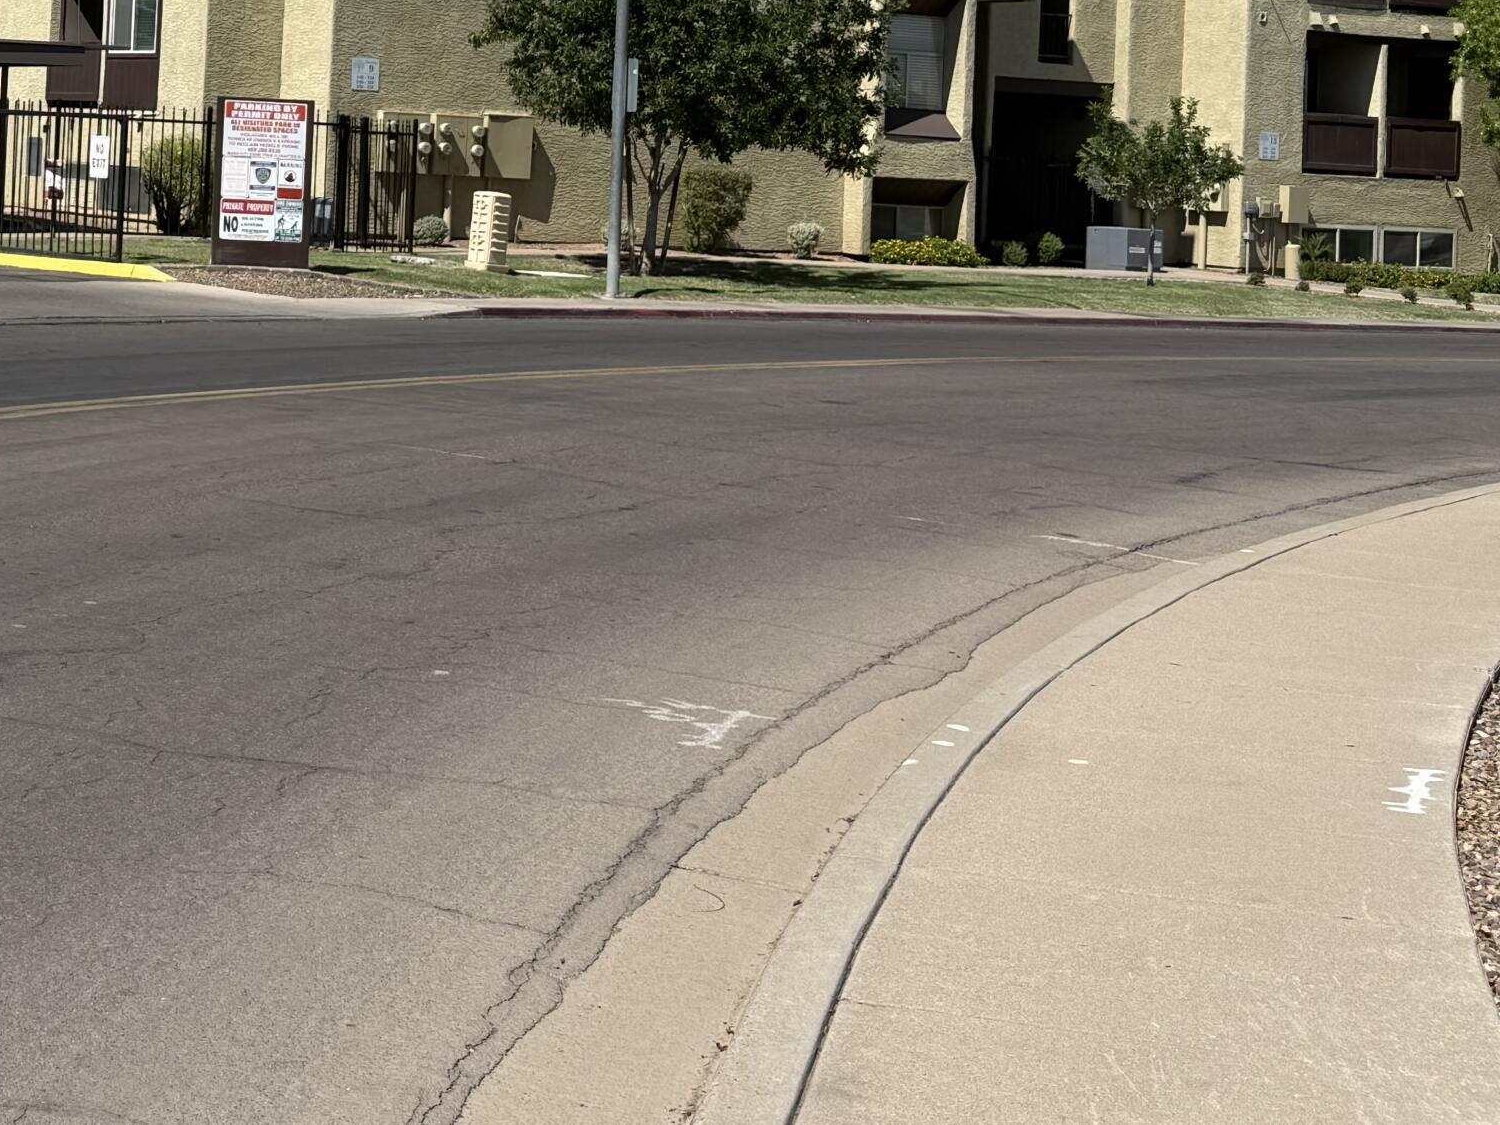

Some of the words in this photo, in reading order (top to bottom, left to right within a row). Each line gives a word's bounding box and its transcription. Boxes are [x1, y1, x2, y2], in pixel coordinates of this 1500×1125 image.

[234, 102, 281, 112] PARKING
[231, 110, 271, 119] PERMIT
[96, 144, 104, 154] NO
[92, 158, 106, 168] EXIT
[222, 202, 244, 211] PRIVATE
[247, 203, 274, 212] PROPERTY
[223, 216, 238, 232] NO
